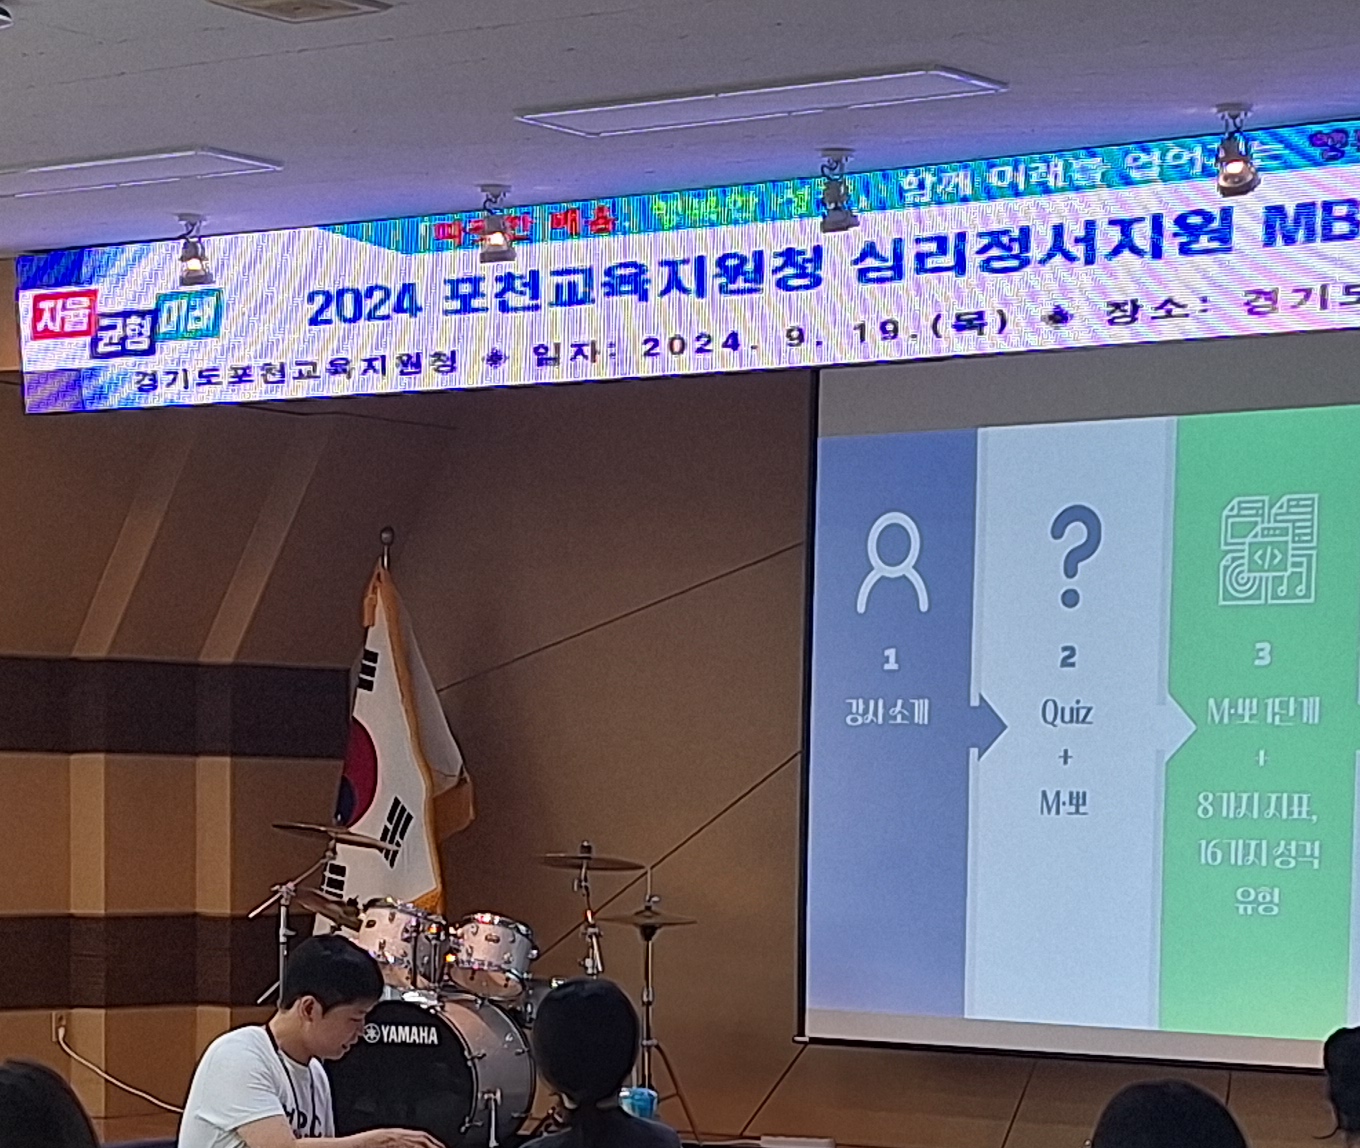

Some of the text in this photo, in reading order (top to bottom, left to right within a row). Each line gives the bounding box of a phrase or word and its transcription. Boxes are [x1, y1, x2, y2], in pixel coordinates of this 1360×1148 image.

[902, 163, 974, 203] 함께
[307, 282, 423, 326] 2024
[443, 244, 824, 316] 포천교육지원청
[852, 205, 1234, 284] 심리정서지원
[135, 349, 457, 392] 경기도포천교육지원청
[883, 647, 899, 671] 1
[1060, 645, 1078, 669] 2
[1253, 642, 1273, 666] 3
[845, 697, 929, 726] 강사 소개
[1042, 699, 1094, 727] Quiz
[1197, 791, 1318, 824] 8가지 지표,
[1198, 838, 1321, 870] 16가지 성격
[1234, 886, 1281, 916] 유형
[381, 1024, 439, 1045] YAMAHA
